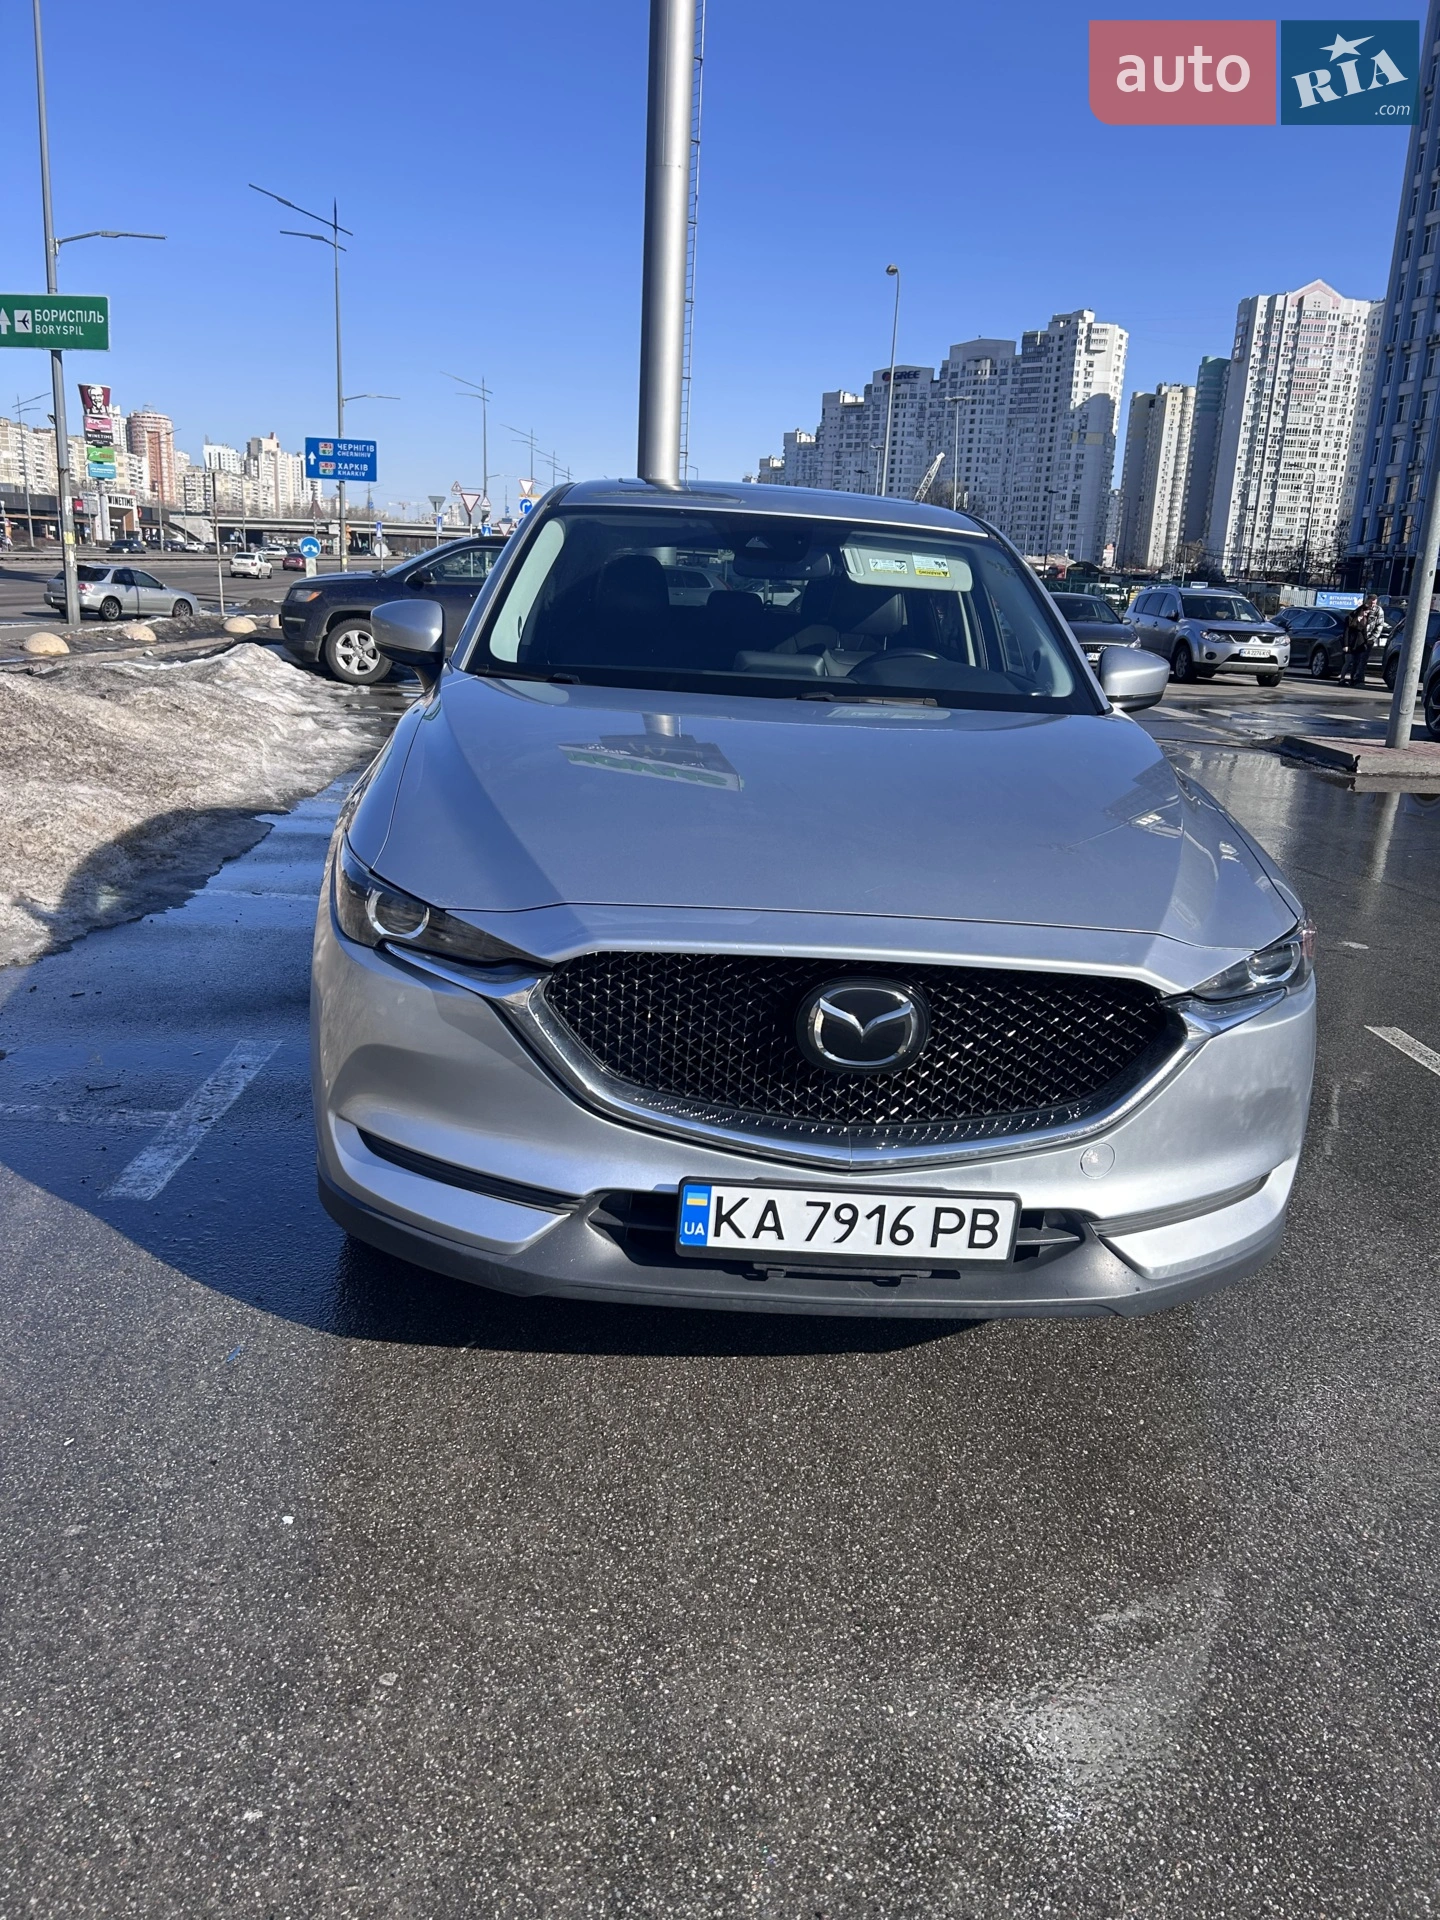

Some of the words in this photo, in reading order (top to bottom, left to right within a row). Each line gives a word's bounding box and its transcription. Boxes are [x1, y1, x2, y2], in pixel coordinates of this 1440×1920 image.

[34, 309, 105, 324] БОРИСПІЛЬ
[35, 325, 84, 336] BORYSPIL
[893, 370, 921, 380] GREE
[337, 443, 375, 452] ЧЕРНІГІВ
[338, 463, 369, 471] ХАРКІВ
[107, 495, 134, 507] WINETIME
[683, 1221, 706, 1236] UA
[713, 1196, 784, 1240] KA
[804, 1201, 917, 1246] 7916
[930, 1206, 1001, 1250] PB
